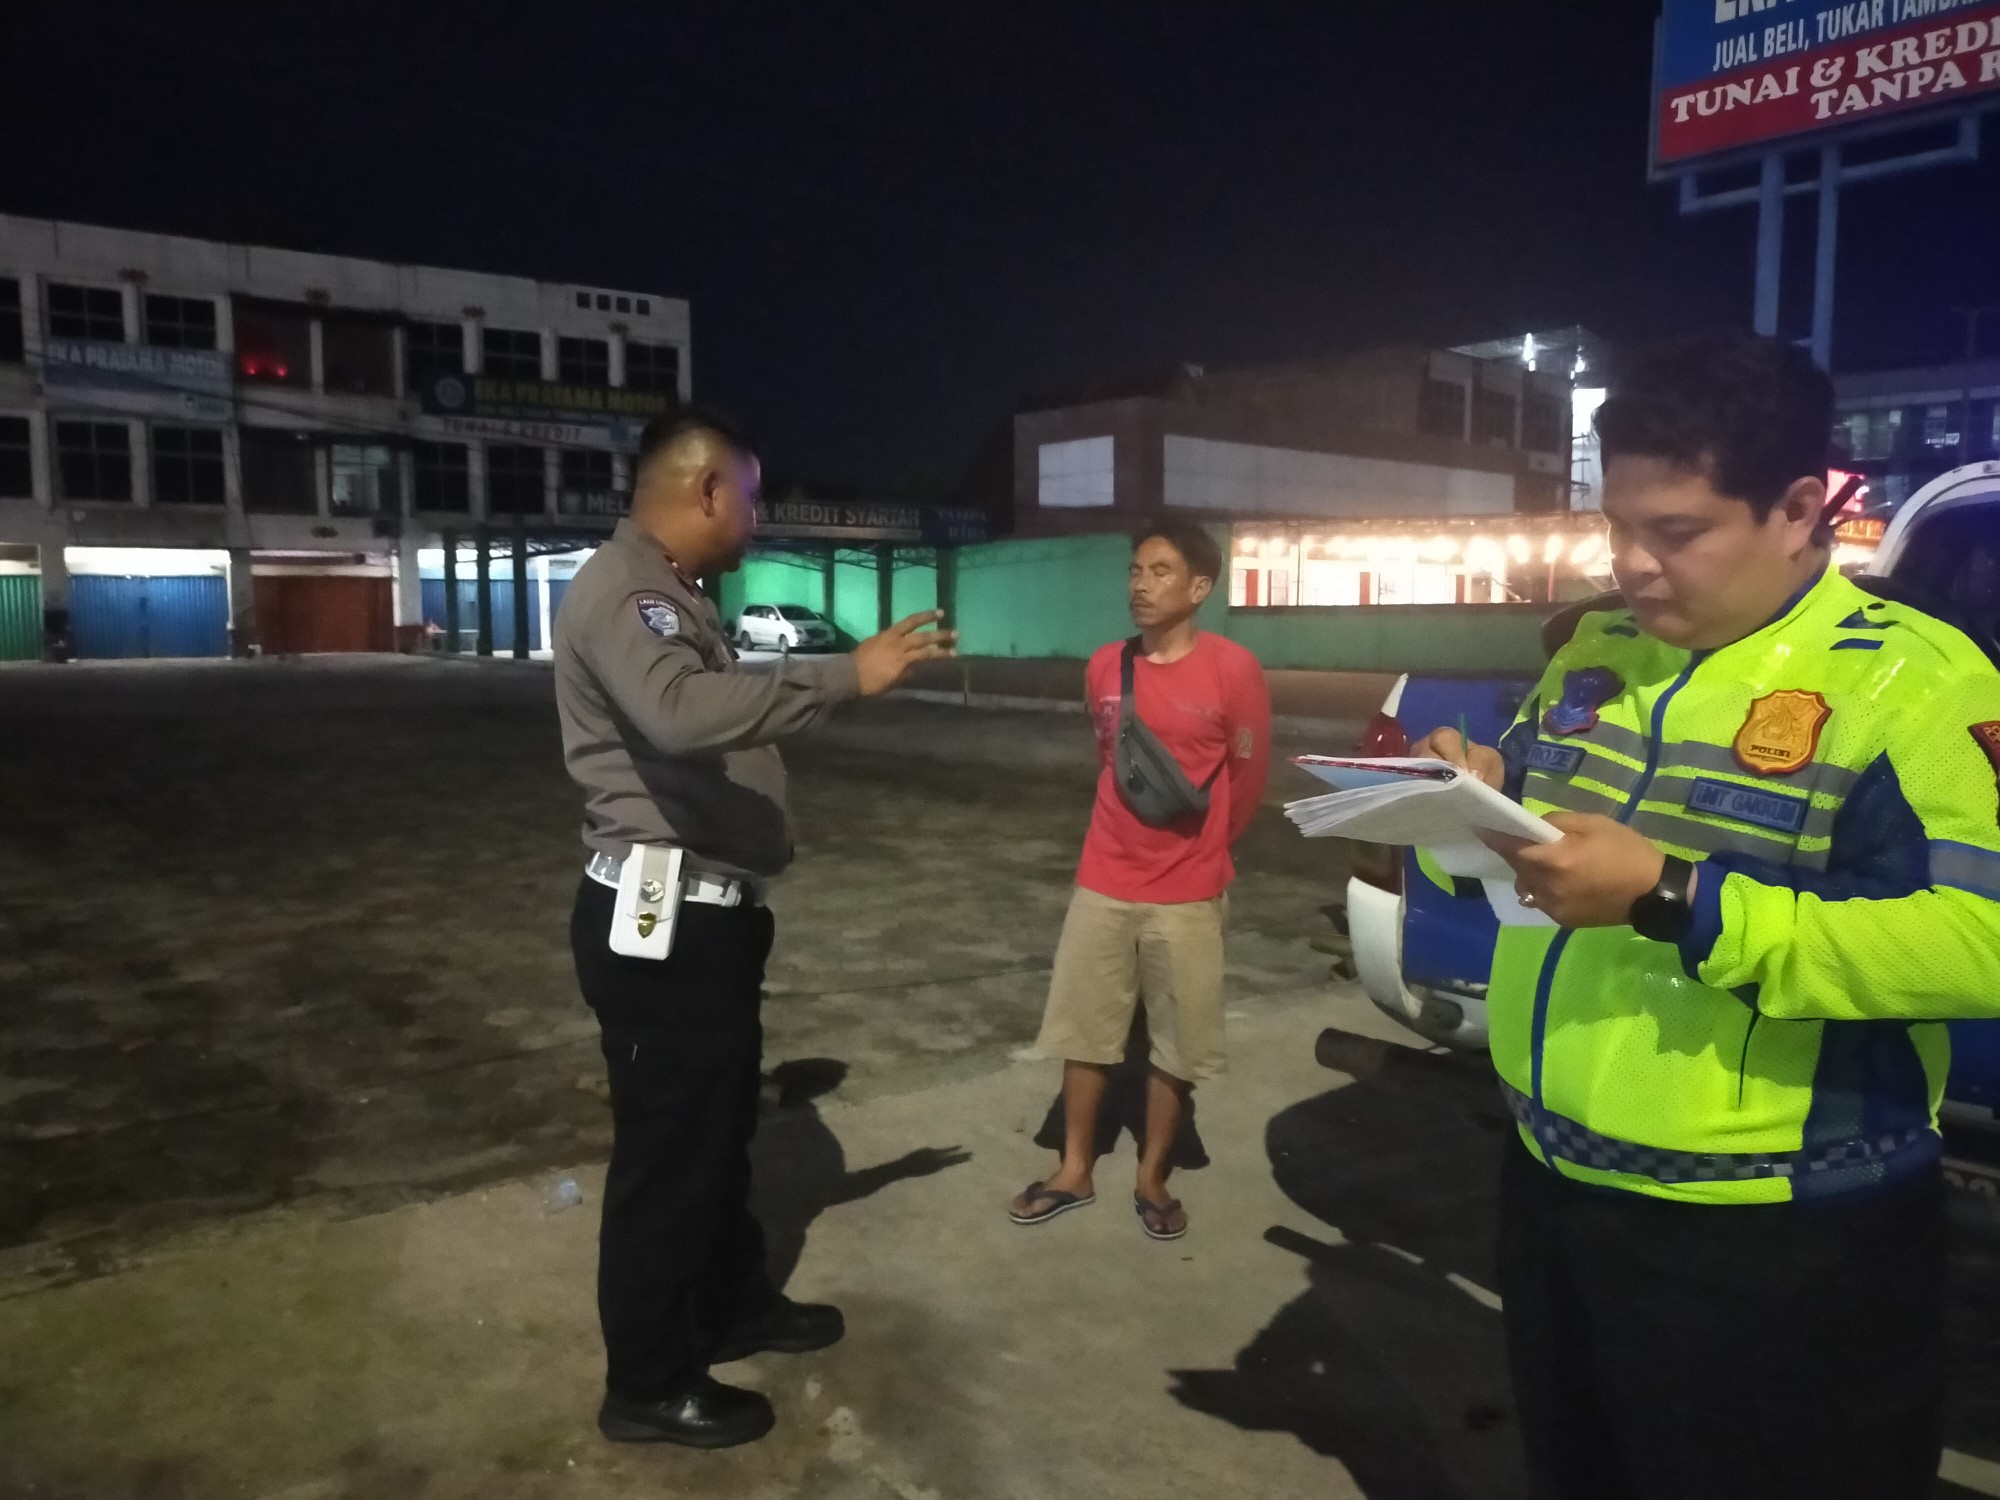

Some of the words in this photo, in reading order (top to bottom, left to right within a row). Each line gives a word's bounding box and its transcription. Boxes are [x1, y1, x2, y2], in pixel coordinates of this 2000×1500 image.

[1712, 32, 1758, 72] JUAL
[1763, 18, 1810, 58] BELI,
[1816, 0, 1884, 43] TUKAR
[1671, 66, 1801, 123] TUNAI
[1809, 56, 1845, 88] &
[1855, 15, 2000, 78] KREDI
[1810, 60, 1968, 120] TANPA
[774, 503, 839, 525] KREDIT
[845, 507, 921, 529] SYARIAH
[1750, 744, 1791, 759] POLISI
